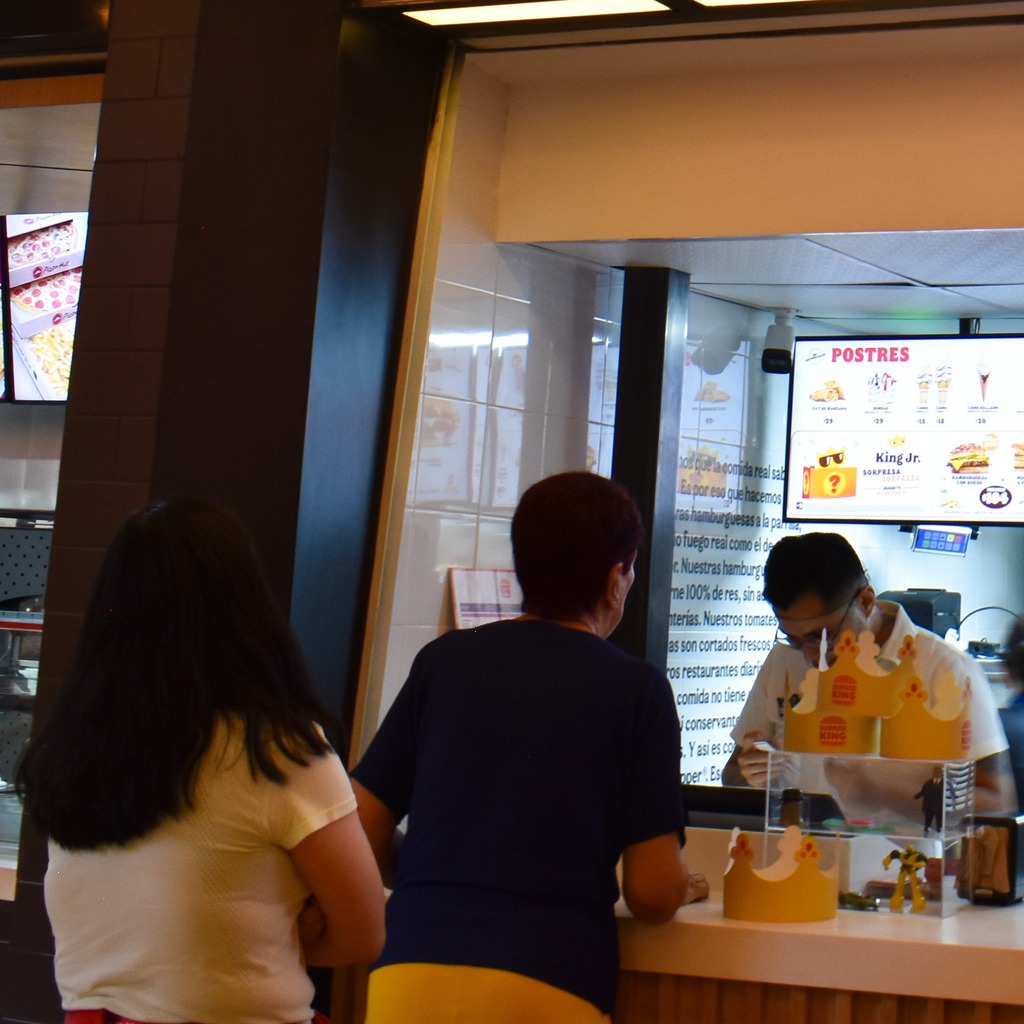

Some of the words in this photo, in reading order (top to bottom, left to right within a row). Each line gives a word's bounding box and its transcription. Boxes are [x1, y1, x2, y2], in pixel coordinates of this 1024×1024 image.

[831, 347, 910, 363] POSTRES
[875, 451, 904, 466] King
[905, 452, 921, 464] Jr.
[720, 460, 753, 476] comida
[754, 464, 771, 479] real
[745, 486, 782, 504] hacemos
[690, 505, 754, 529] hamburguesas
[683, 530, 709, 552] fuego
[711, 534, 728, 550] real
[729, 538, 752, 552] como
[680, 557, 721, 575] Nuestras
[686, 583, 711, 601] 100%
[712, 585, 723, 601] de
[743, 586, 755, 601] sin
[703, 610, 742, 626] Nuestros
[745, 614, 778, 627] tomates
[681, 639, 697, 653] son
[699, 636, 738, 653] cortados
[740, 635, 771, 651] frescos
[682, 664, 738, 679] restaurantes
[677, 688, 709, 705] comida
[711, 692, 722, 704] no
[724, 687, 746, 703] tiene
[697, 739, 709, 756] así
[711, 743, 721, 755] es
